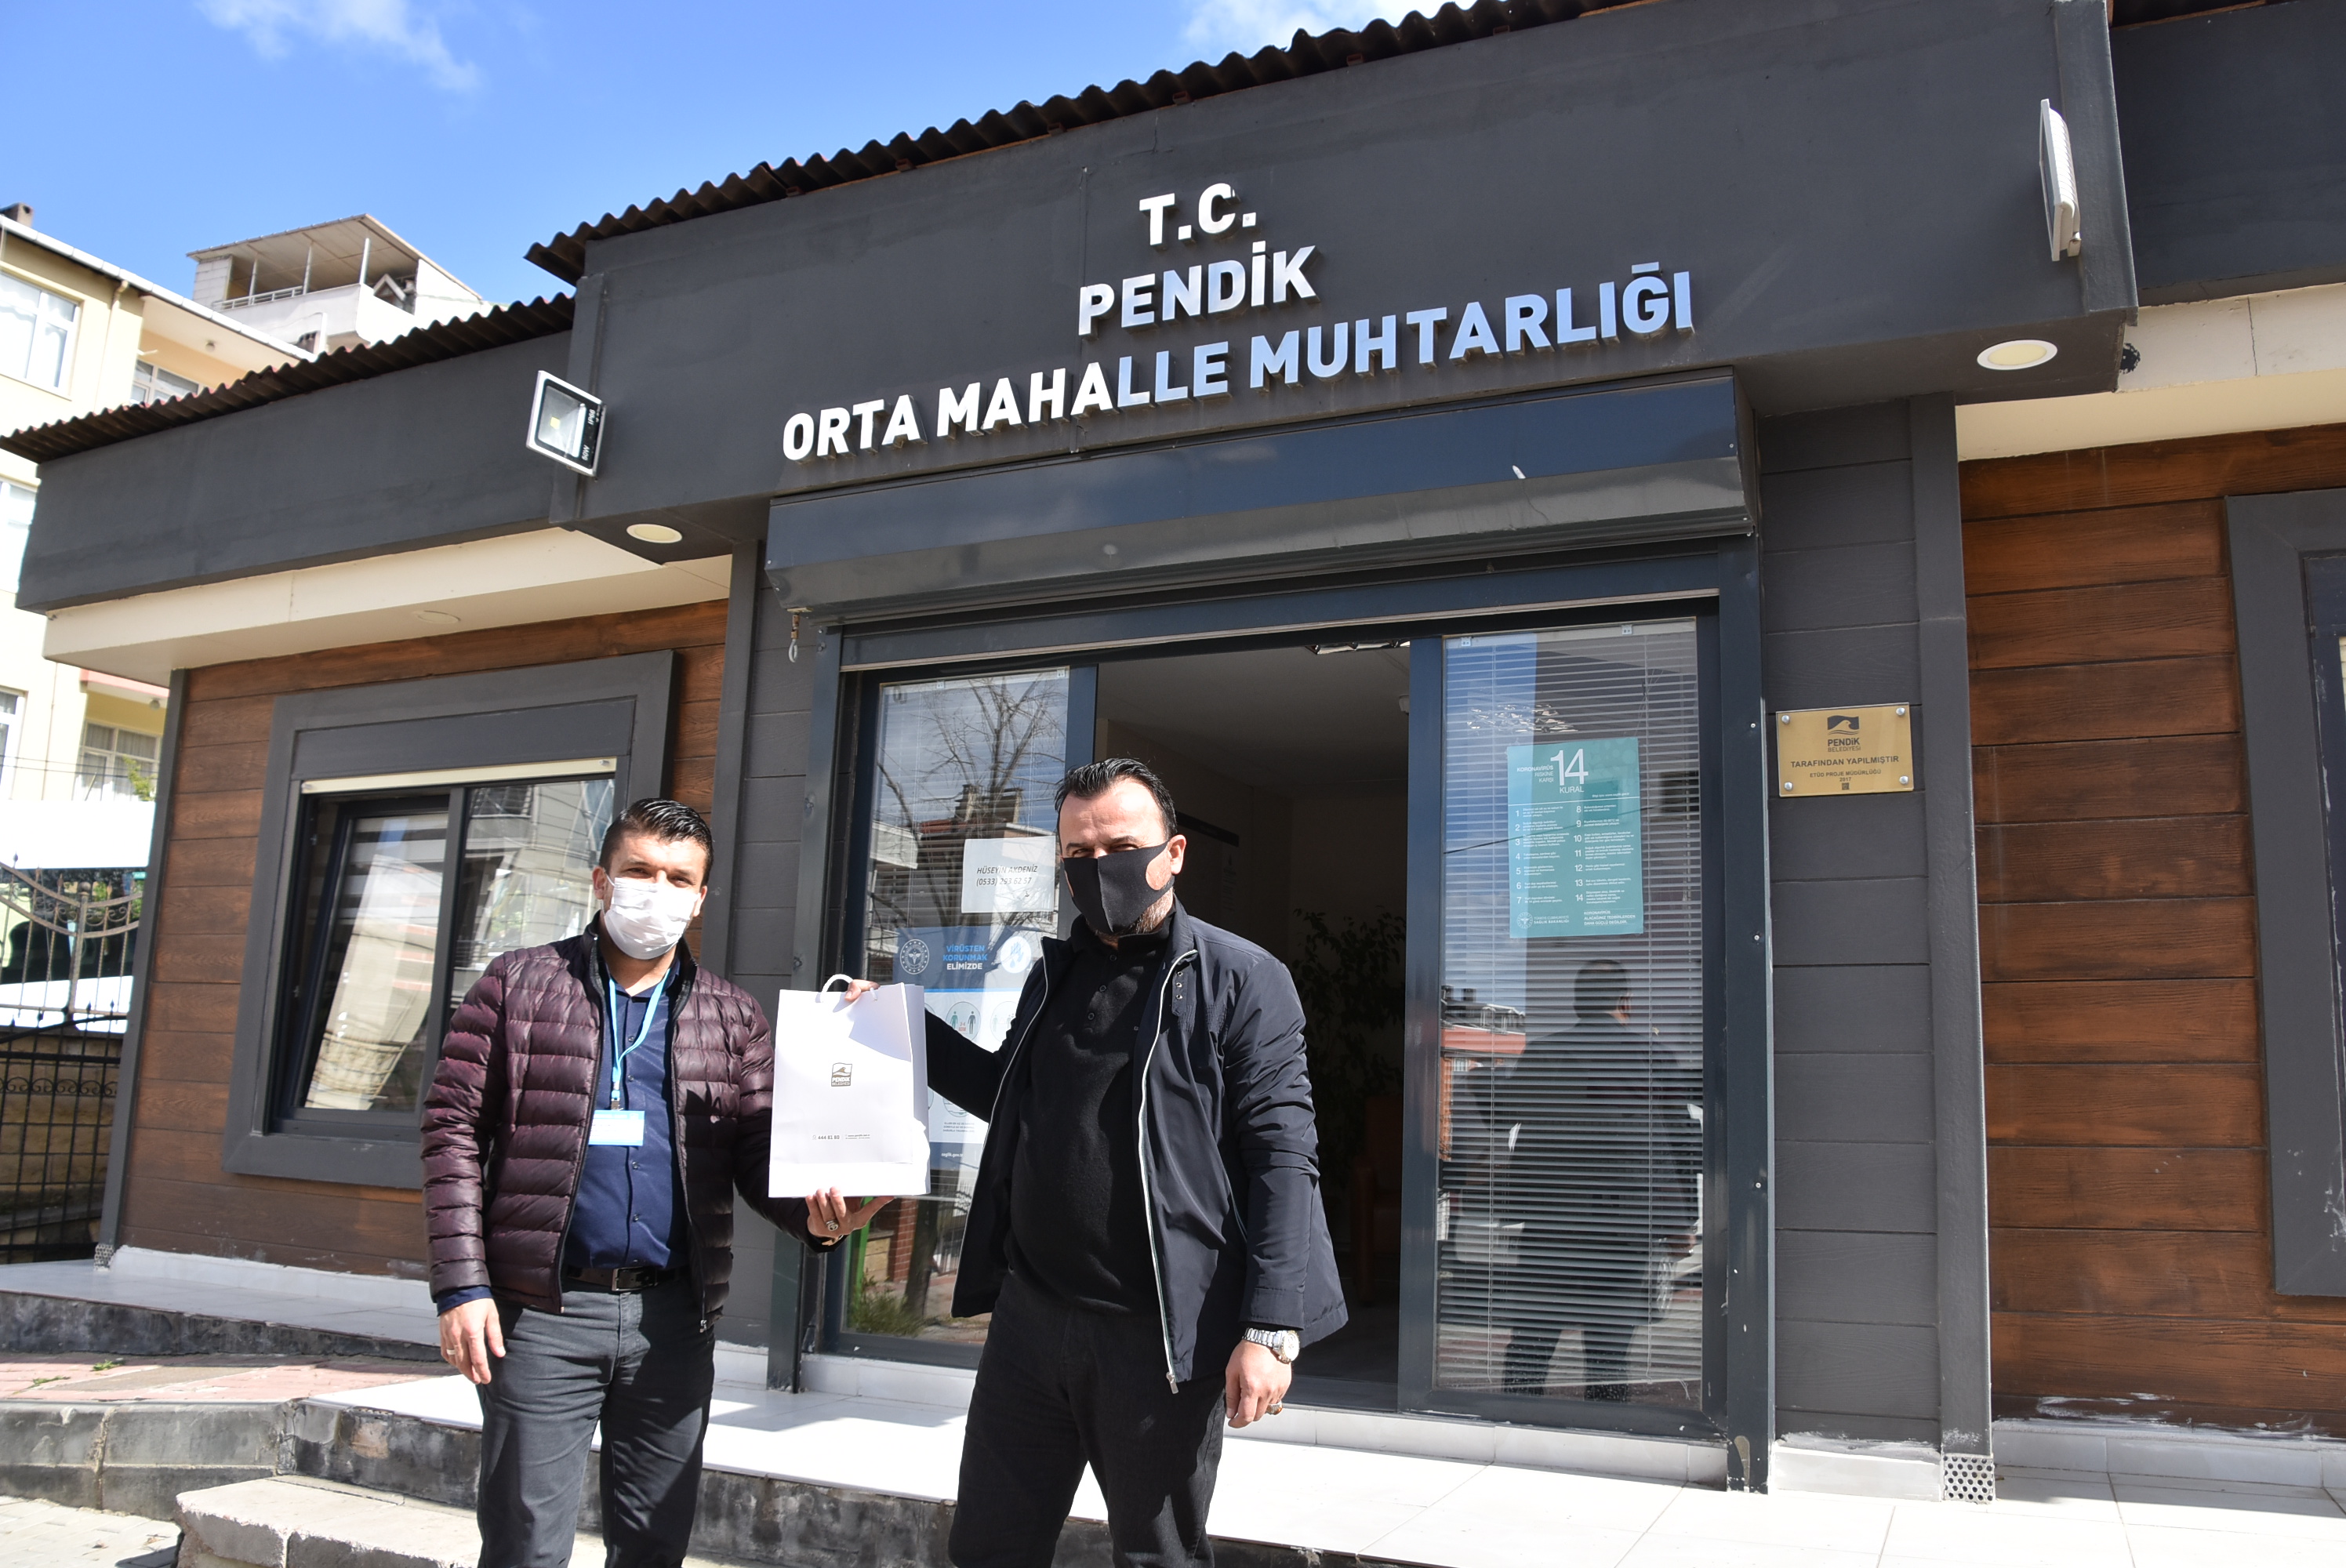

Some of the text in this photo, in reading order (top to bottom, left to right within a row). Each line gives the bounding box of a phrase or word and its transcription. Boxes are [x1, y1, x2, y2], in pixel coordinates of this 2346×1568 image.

[1139, 183, 1256, 245] T.C.
[1079, 240, 1316, 336] PENDİK
[783, 262, 1691, 461] ORTA MAHALLE MUHTARLIĞI
[1550, 748, 1589, 786] 14
[1791, 755, 1899, 768] TARAFINDAN YAPILMIŞTIR
[1560, 786, 1585, 794] KURAL
[976, 864, 1038, 874] HÜSEYİN AKDENİZ
[976, 877, 997, 887] (0533)
[946, 944, 986, 953] VİRÜSTEN
[946, 961, 982, 971] ELİMİZDE
